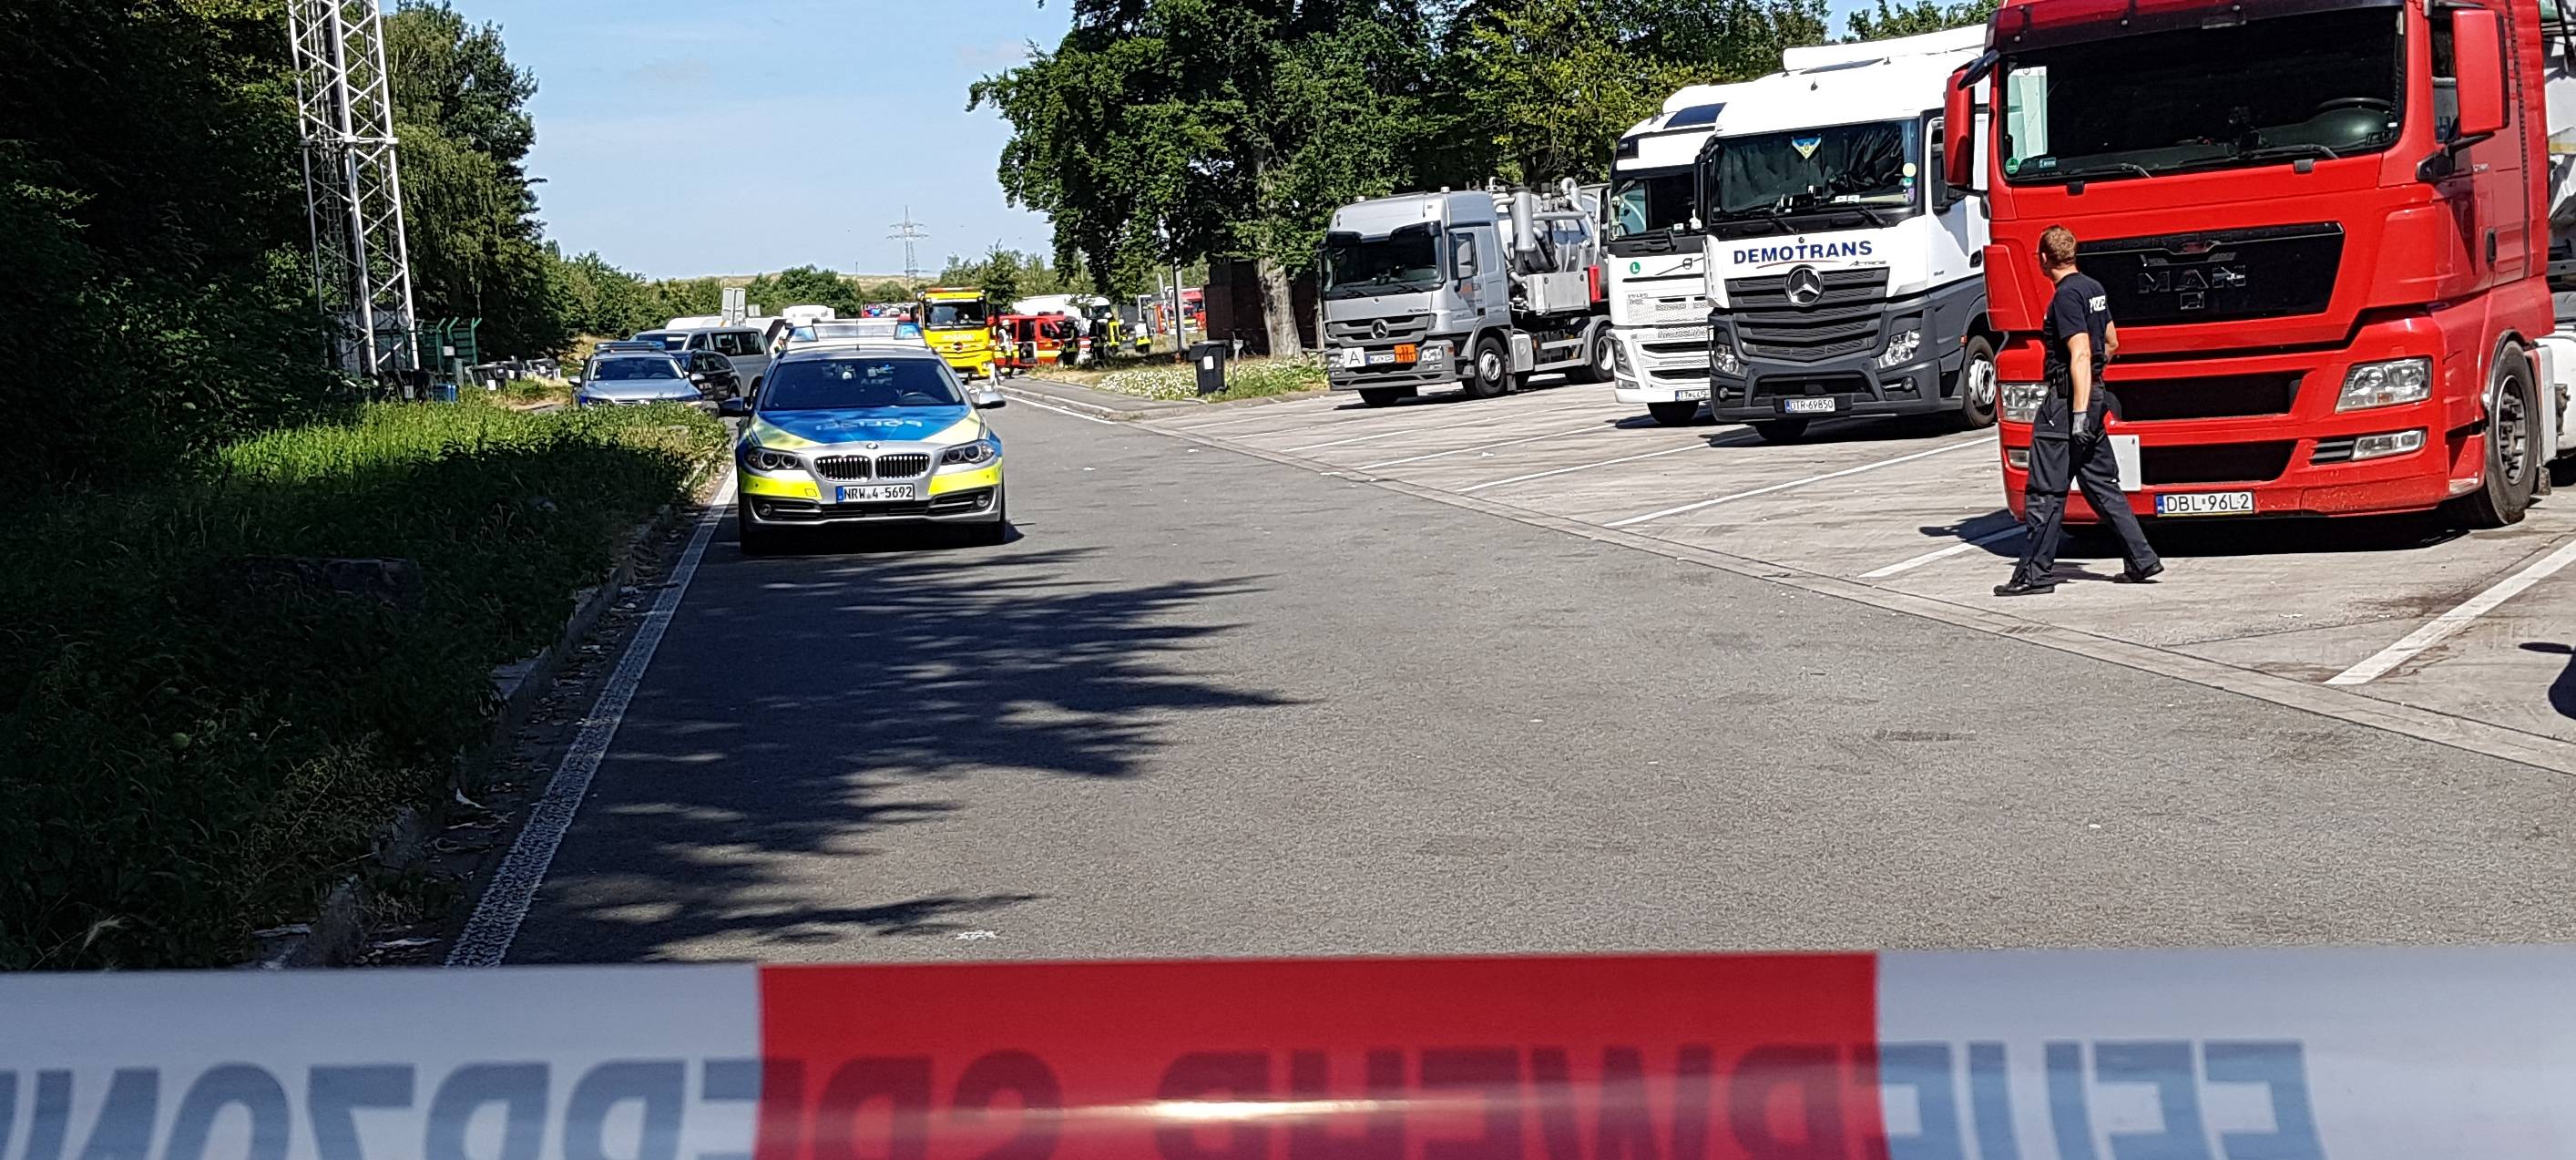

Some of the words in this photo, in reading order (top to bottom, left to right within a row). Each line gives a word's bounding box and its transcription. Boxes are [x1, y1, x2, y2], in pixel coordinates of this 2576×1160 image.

[1733, 240, 1873, 264] DEMOTRANS
[2137, 265, 2246, 293] MAN
[1349, 350, 1361, 364] A
[843, 488, 866, 500] NRW
[2166, 496, 2202, 512] DBL
[2208, 493, 2250, 511] 96L2
